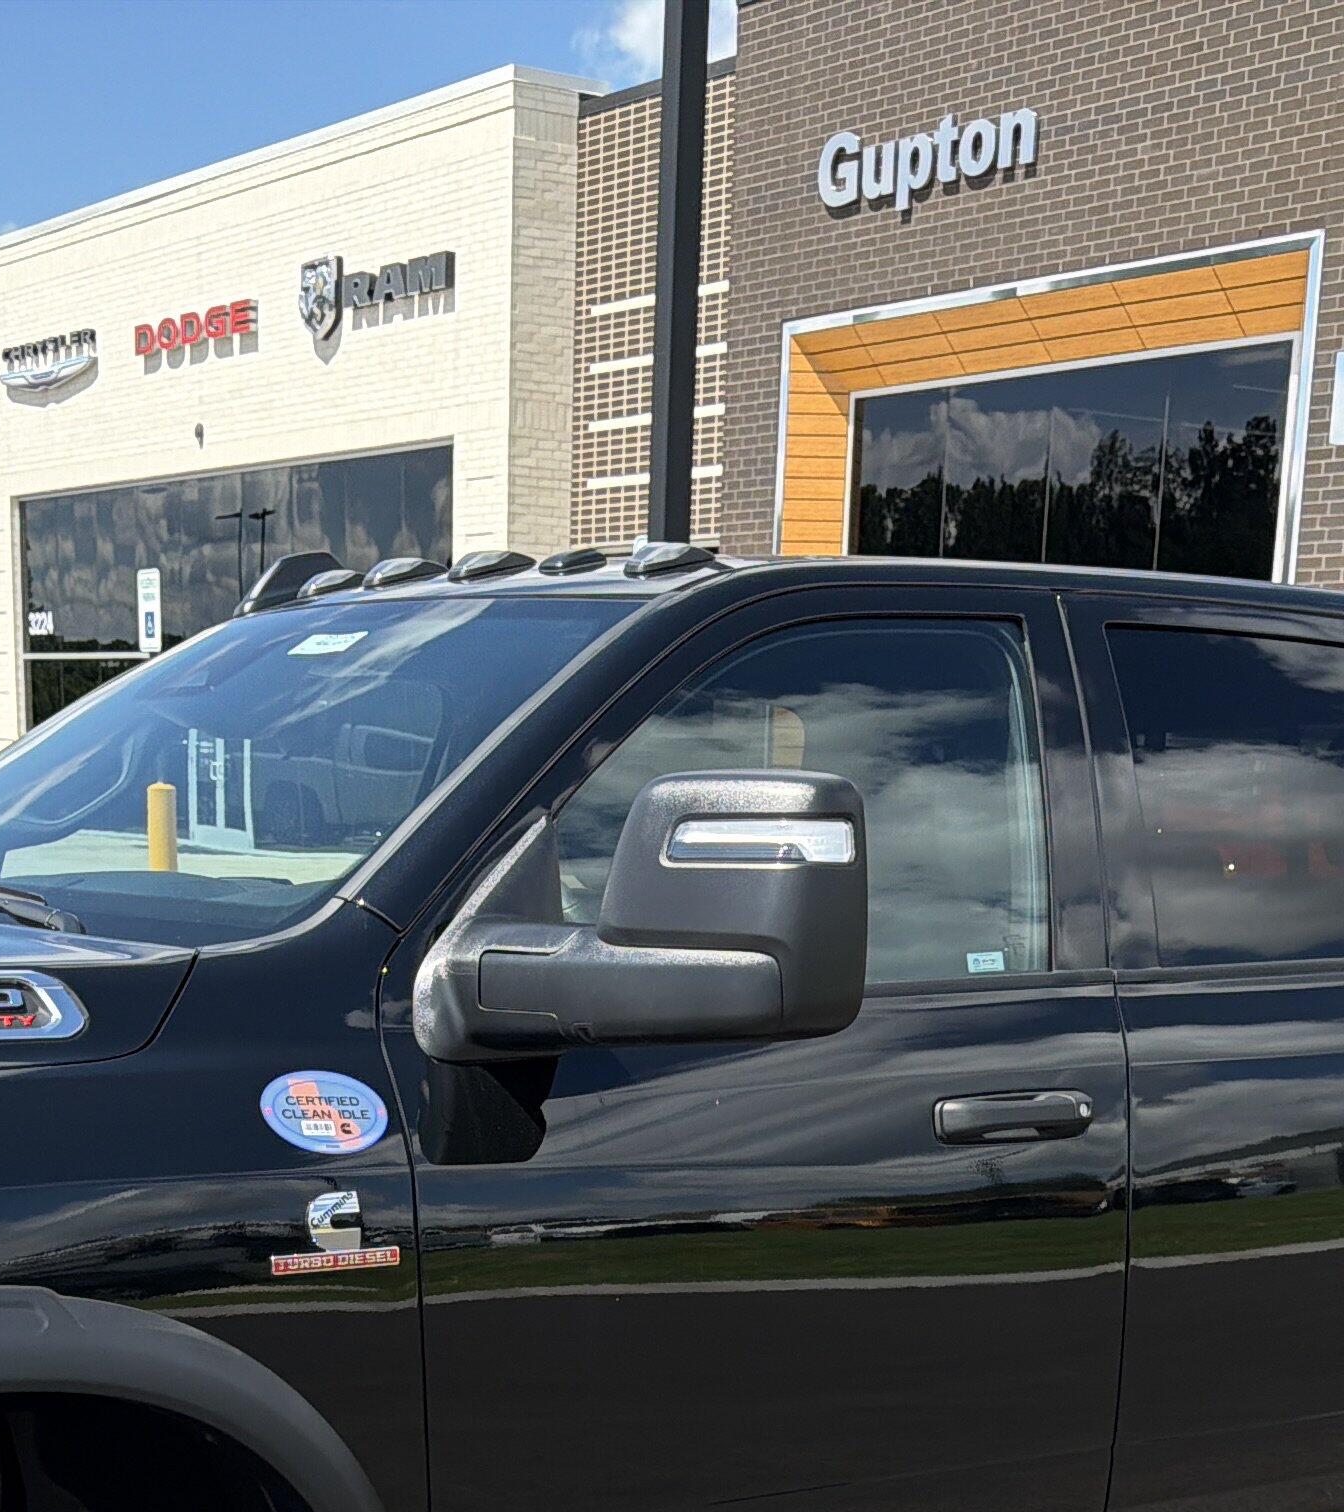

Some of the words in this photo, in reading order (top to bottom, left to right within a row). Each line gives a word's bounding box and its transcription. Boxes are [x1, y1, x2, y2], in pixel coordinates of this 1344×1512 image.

[818, 107, 1039, 212] Gupton
[343, 250, 456, 307] RAM
[135, 298, 256, 356] DODGE
[281, 1109, 332, 1120] CLEAN
[338, 1109, 371, 1120] IDLE
[285, 1095, 360, 1106] CERTIFIED
[311, 1190, 354, 1228] Cummins
[276, 1255, 335, 1271] TURBO
[337, 1249, 396, 1266] DIESEL
